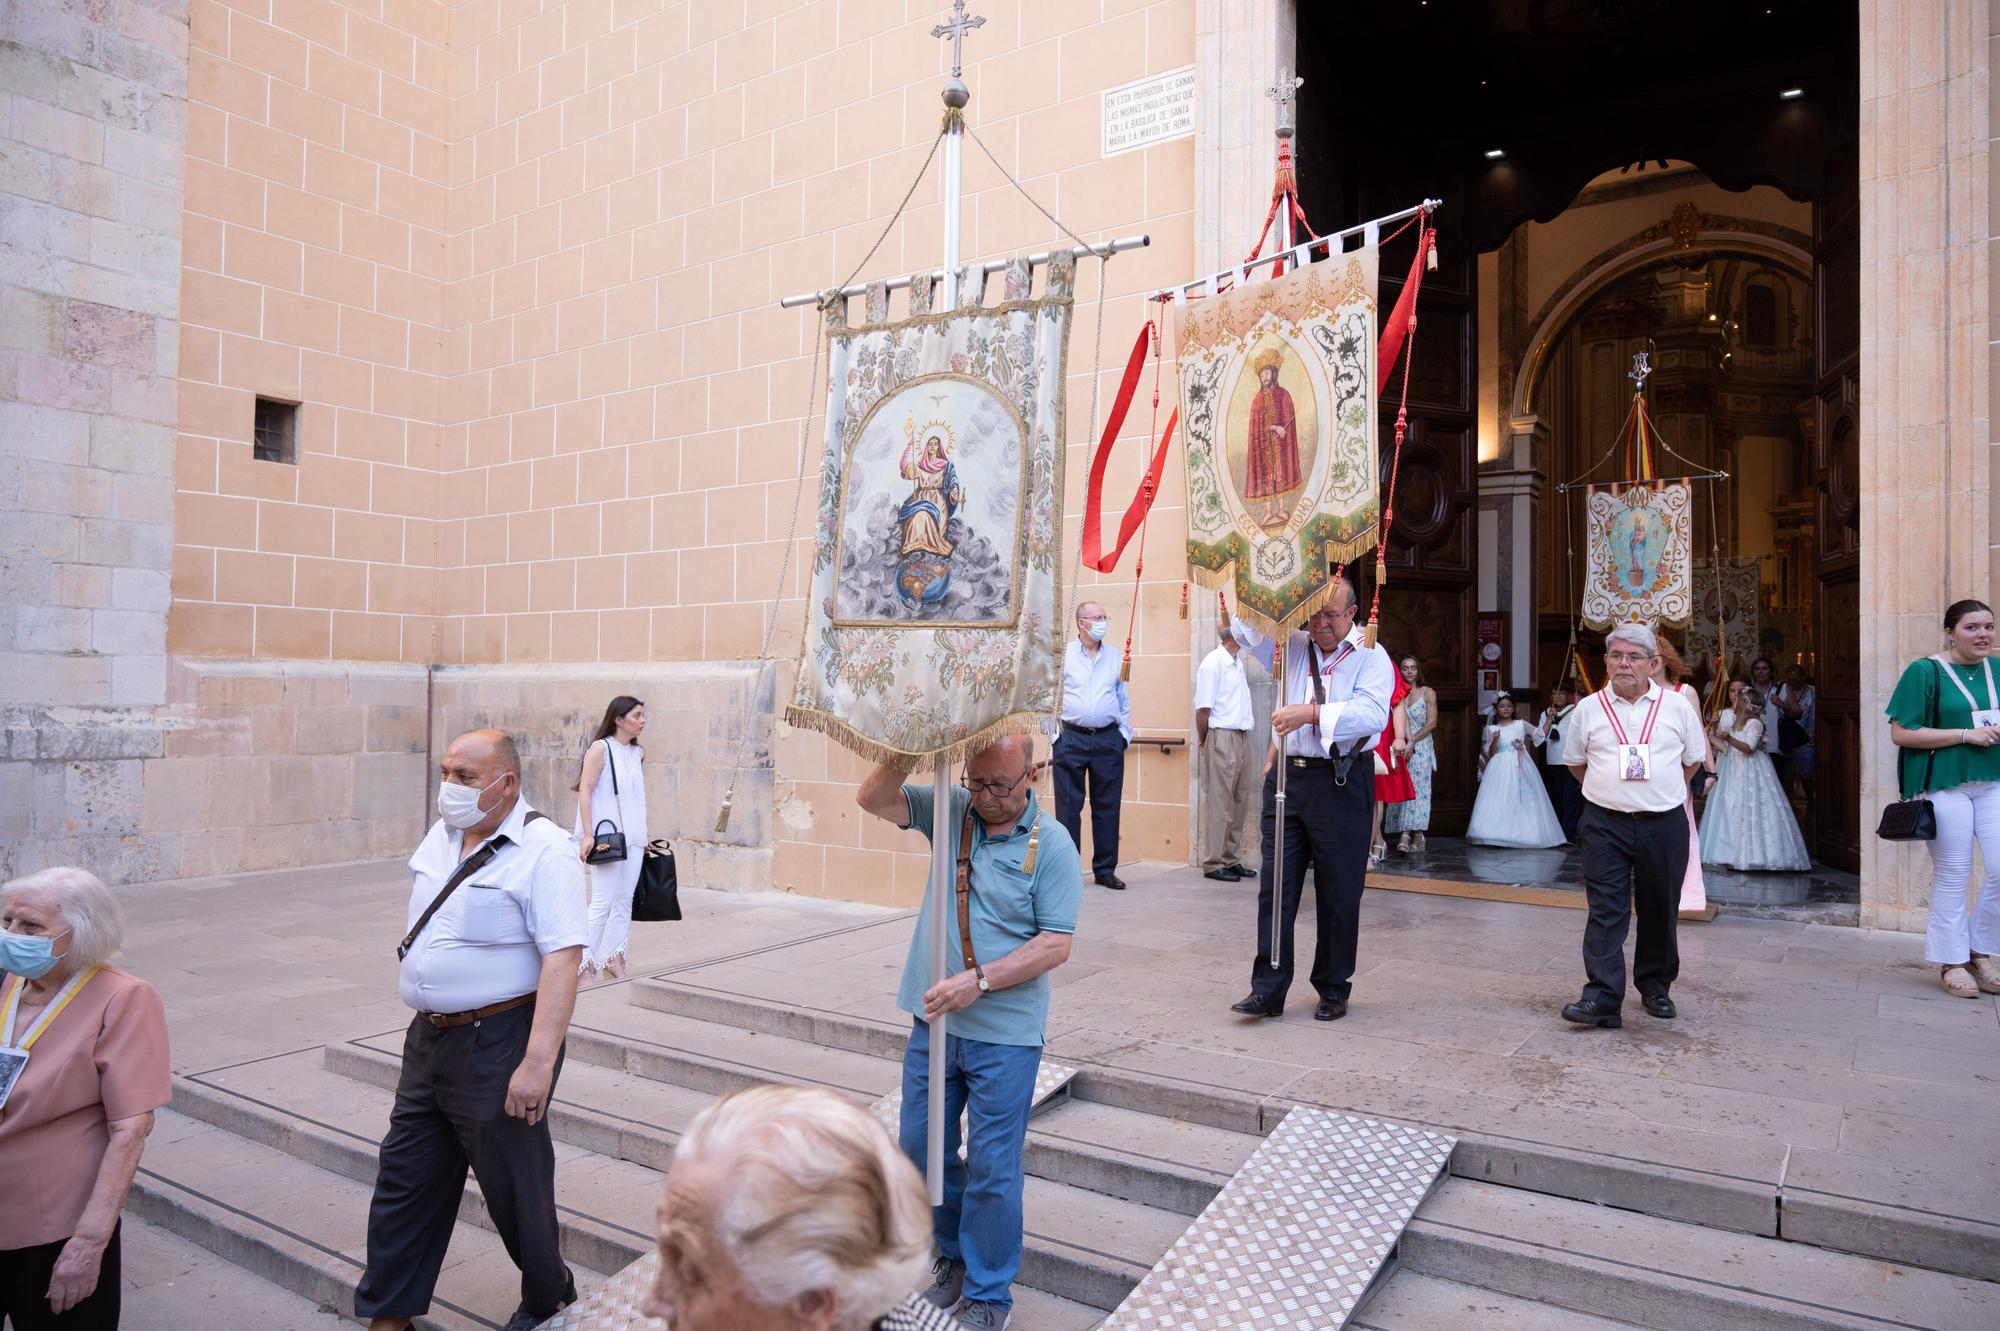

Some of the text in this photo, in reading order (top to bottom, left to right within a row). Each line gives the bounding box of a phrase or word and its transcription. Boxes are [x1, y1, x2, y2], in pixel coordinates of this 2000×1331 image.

[1116, 94, 1131, 105] ESTA
[1107, 110, 1118, 122] LAS
[1110, 124, 1118, 134] EN
[1120, 120, 1128, 132] LA
[1170, 104, 1190, 118] SANTA
[1238, 496, 1314, 541] ECCE HOMO
